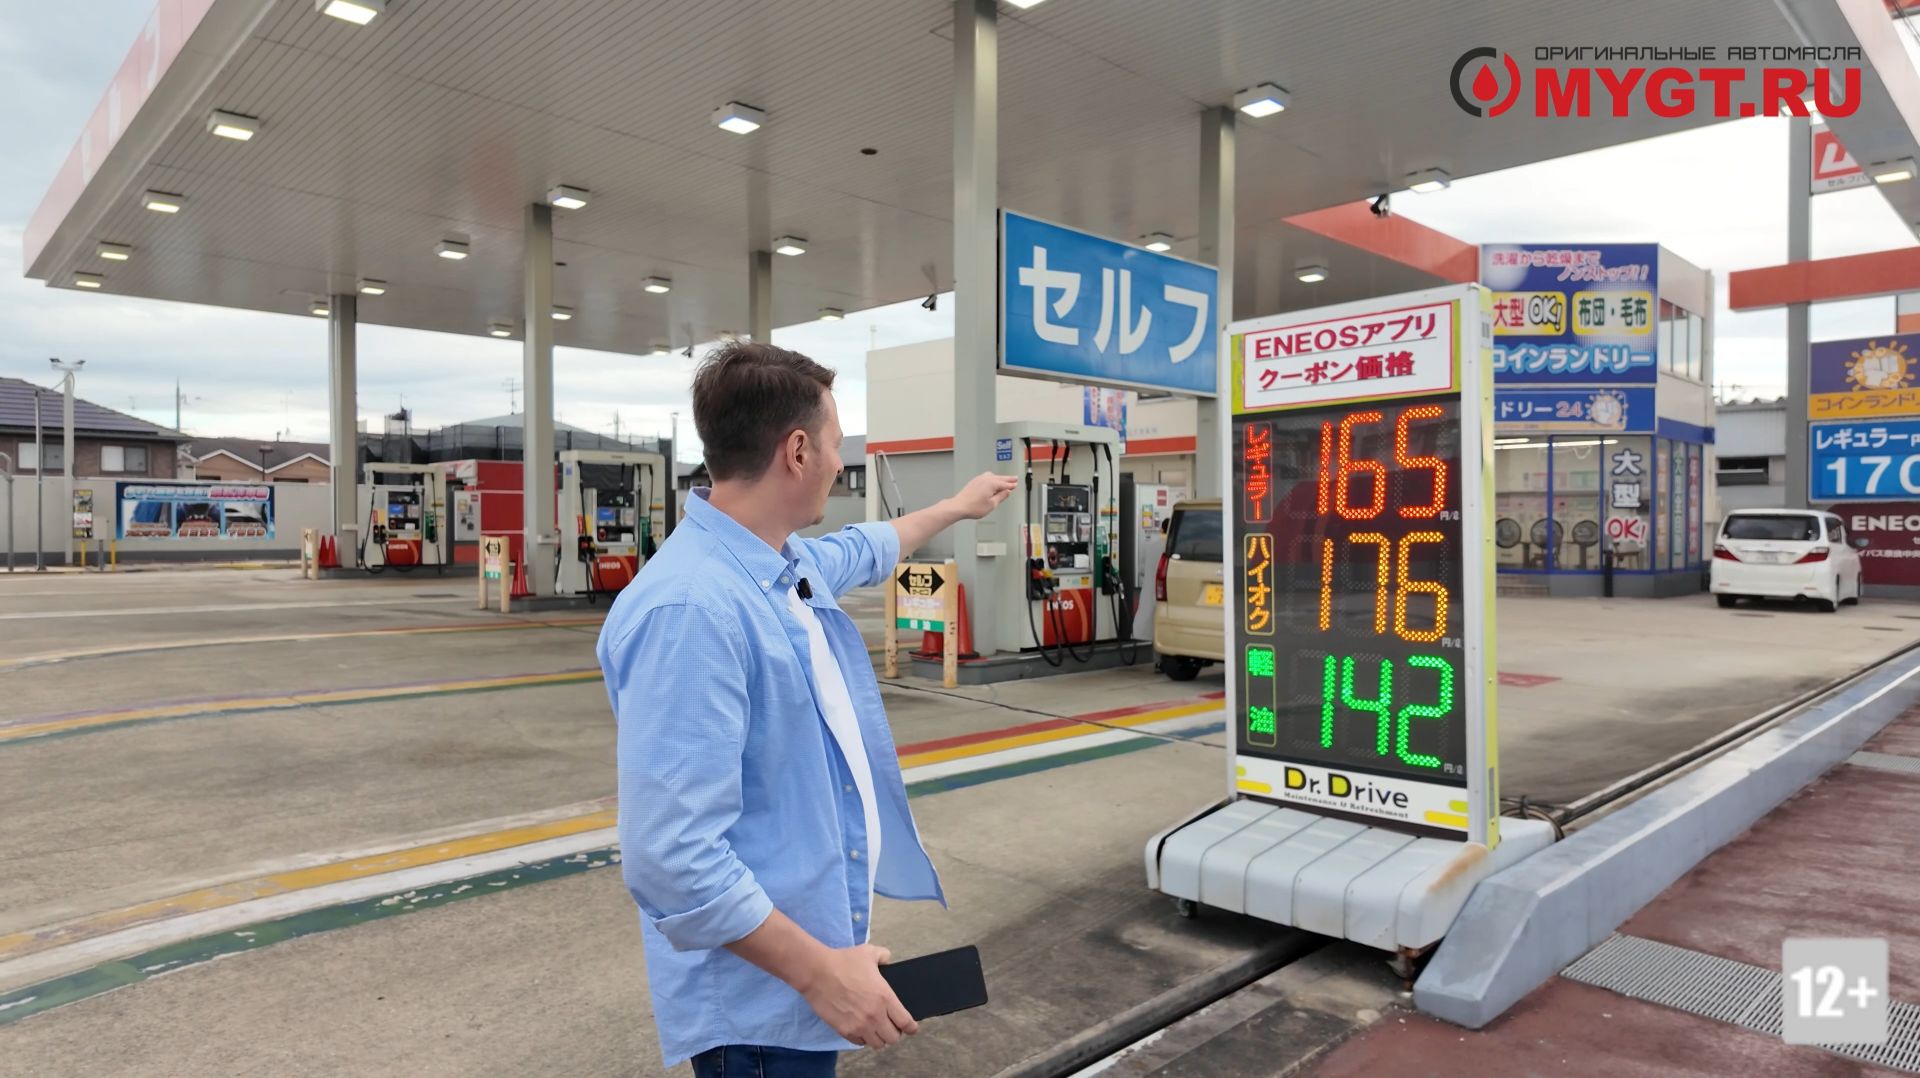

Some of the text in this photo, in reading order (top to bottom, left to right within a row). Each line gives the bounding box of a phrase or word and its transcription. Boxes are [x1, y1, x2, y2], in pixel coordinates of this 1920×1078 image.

[1018, 245, 1209, 364] セルフ
[1493, 295, 1562, 331] 大型 OK!
[1579, 297, 1647, 327] 布団・毛布
[1255, 313, 1436, 359] ENEOSアプリ
[1259, 350, 1415, 390] クーポン価格
[1493, 346, 1651, 371] コインランドリー
[1556, 401, 1583, 418] 24
[1816, 427, 1908, 450] レギュラー
[1246, 424, 1271, 521] レギュラー
[1317, 406, 1447, 520] 165
[1612, 449, 1642, 509] 大型
[1606, 517, 1646, 548] OK!
[1248, 536, 1271, 631] ハイオク
[1319, 531, 1449, 643] 176
[1320, 654, 1455, 769] 142
[1284, 766, 1409, 809] Dr. Drive
